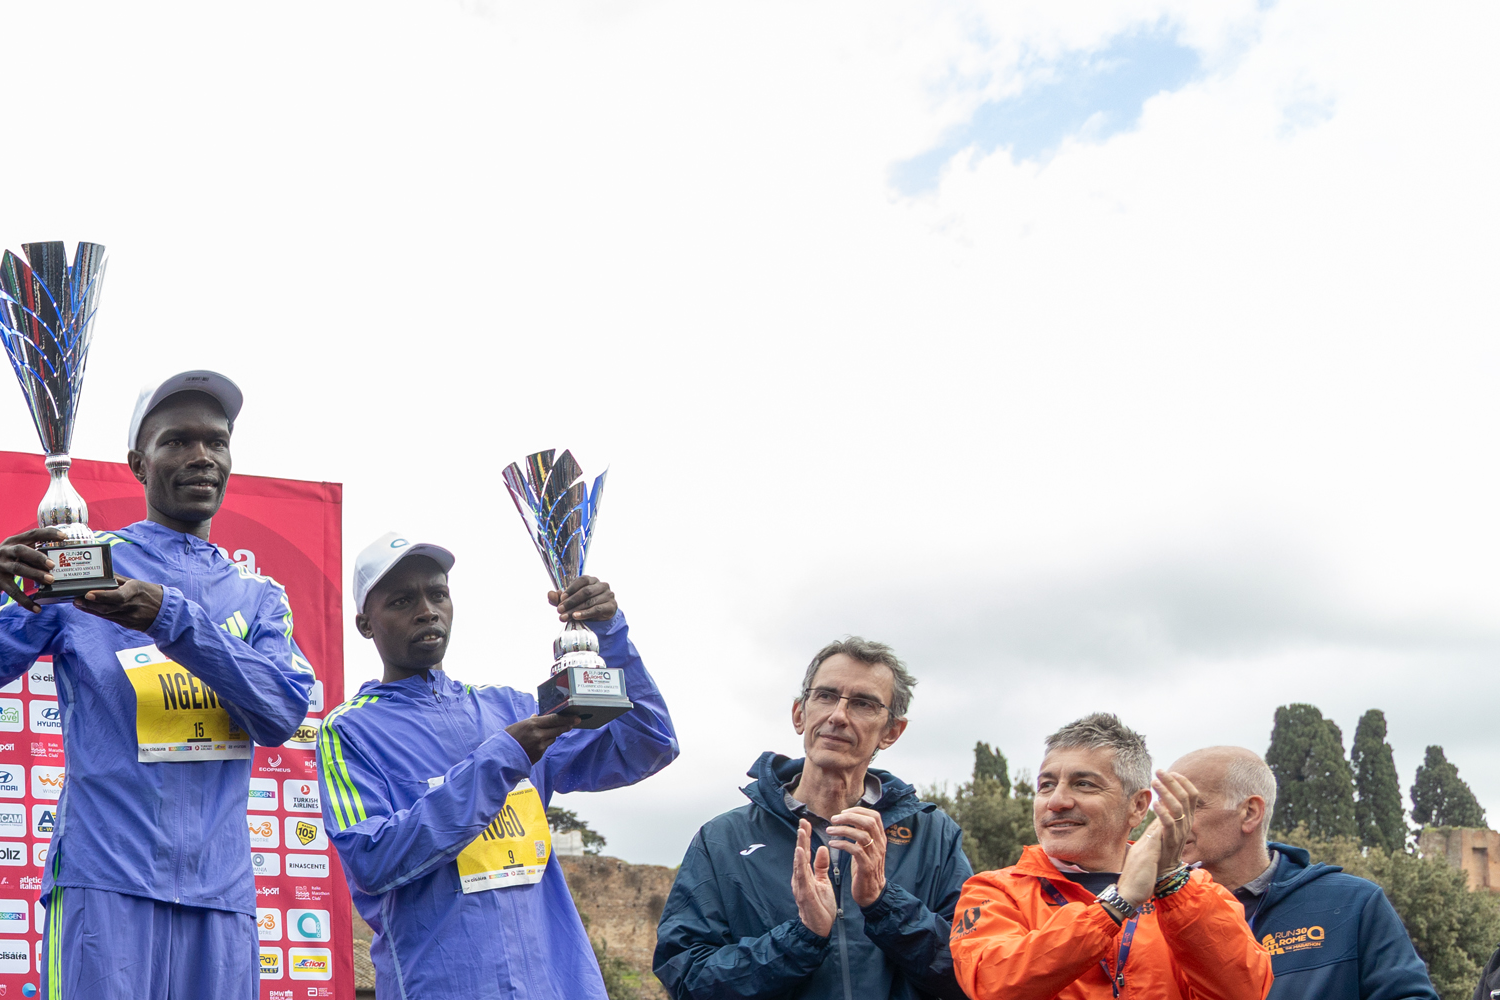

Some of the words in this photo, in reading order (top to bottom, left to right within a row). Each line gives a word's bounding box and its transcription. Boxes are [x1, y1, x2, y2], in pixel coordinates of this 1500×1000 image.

[193, 722, 204, 738] 15
[298, 828, 315, 839] 105
[507, 850, 515, 864] 9
[1279, 934, 1307, 946] ROME
